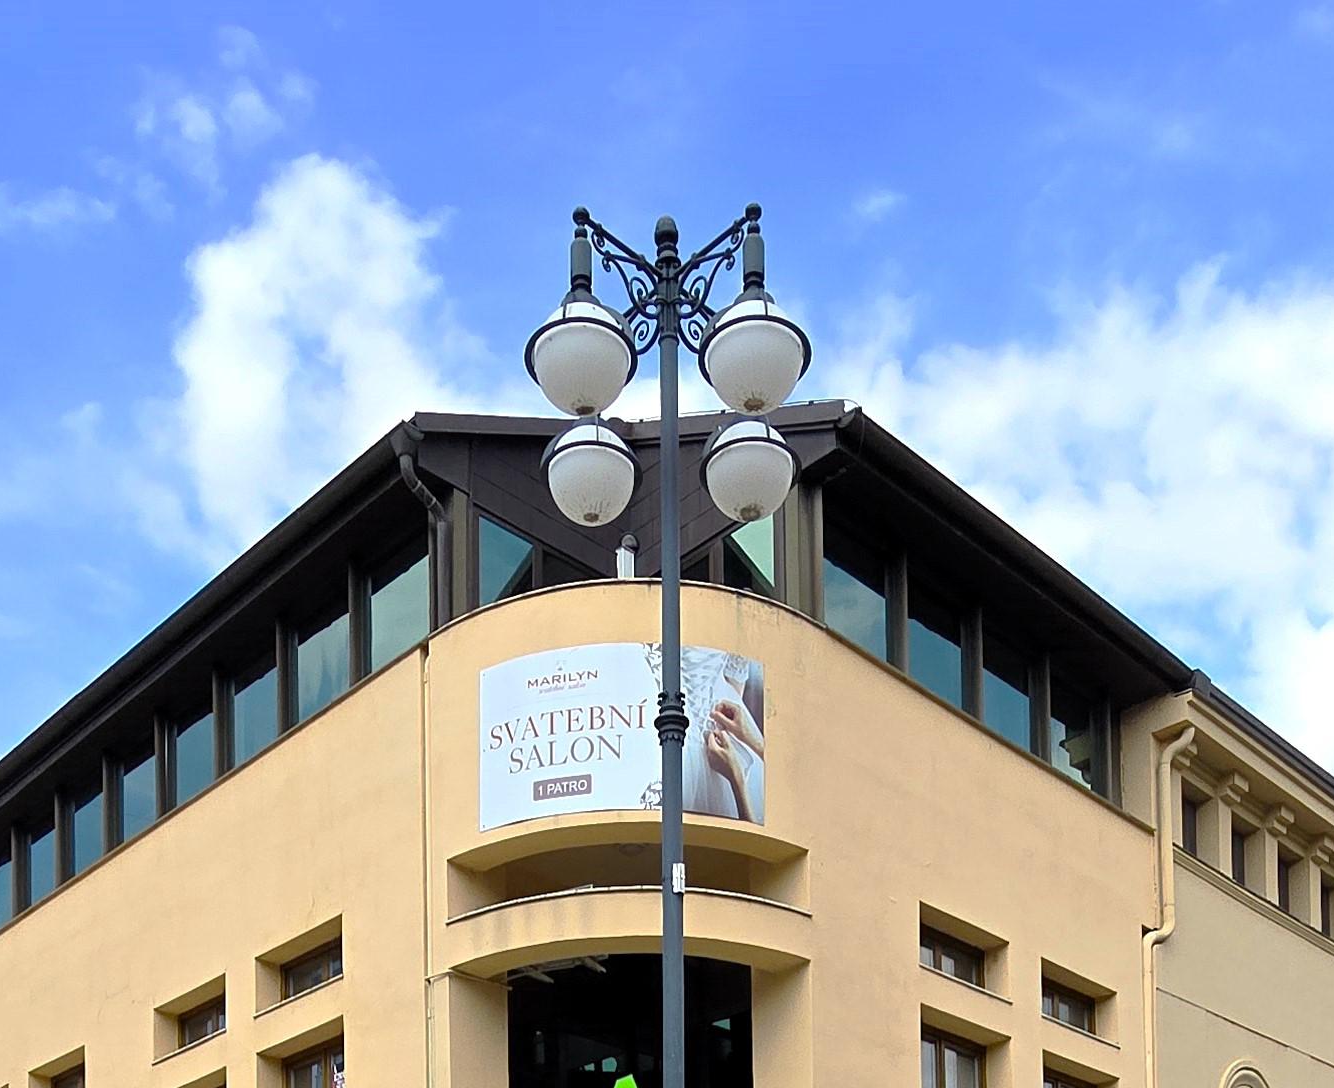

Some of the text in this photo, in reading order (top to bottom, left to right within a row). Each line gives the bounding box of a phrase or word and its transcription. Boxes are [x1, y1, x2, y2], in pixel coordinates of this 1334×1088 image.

[527, 669, 598, 688] MARILYN
[489, 699, 647, 750] SVATEBNÍ
[509, 734, 623, 775] SALON
[537, 780, 588, 796] 1 PATRO
